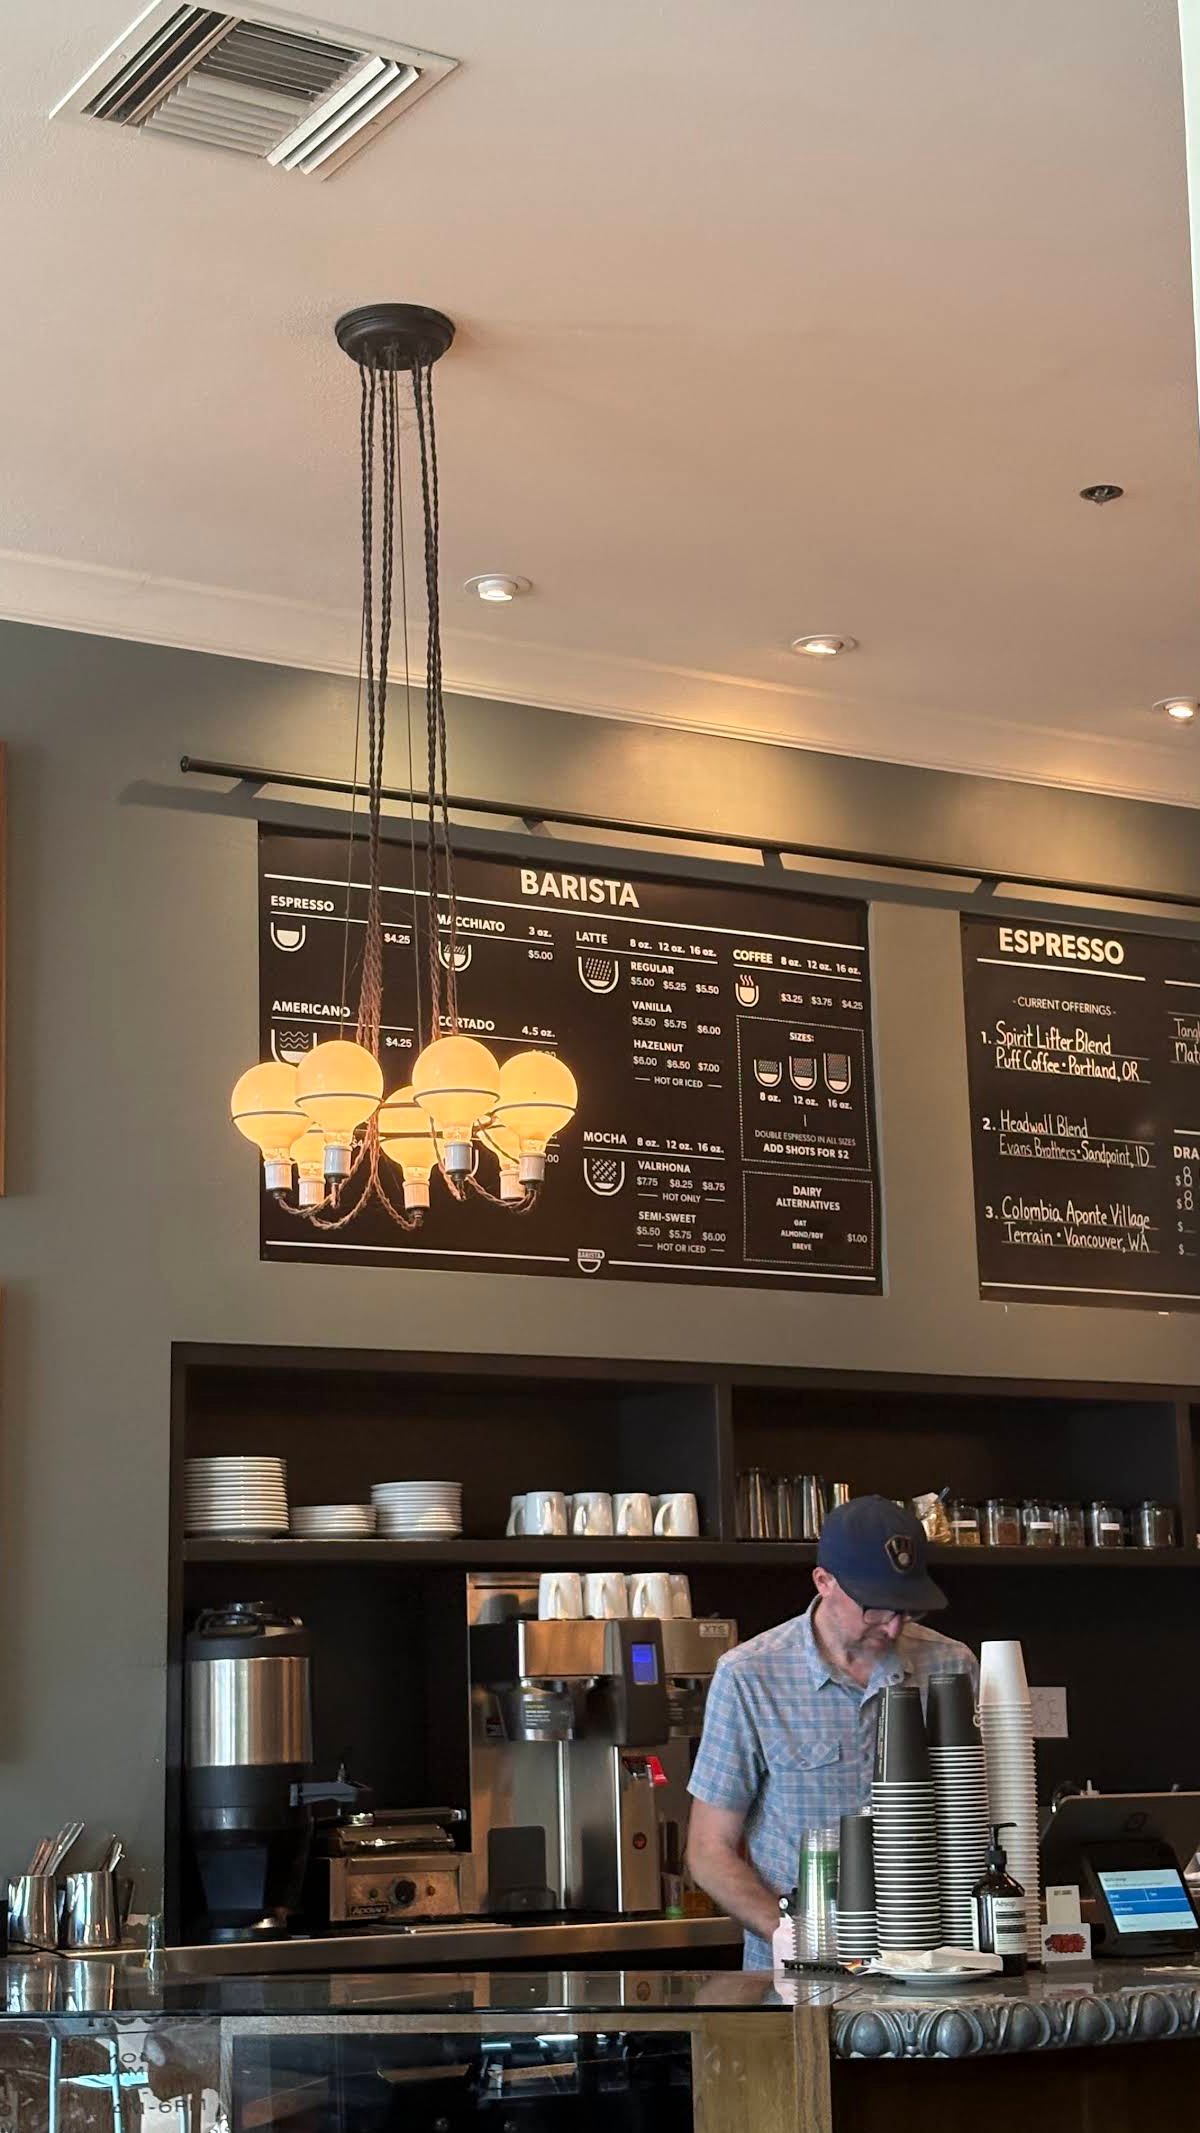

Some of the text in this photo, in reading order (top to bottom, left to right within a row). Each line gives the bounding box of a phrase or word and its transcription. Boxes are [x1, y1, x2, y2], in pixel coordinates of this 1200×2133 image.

[520, 869, 640, 909] BARISTA
[270, 895, 334, 912] ESPRESSO
[384, 932, 410, 944] $4.25
[528, 926, 535, 936] 3
[536, 929, 552, 938] oz.
[576, 930, 717, 957] LATTE 8 oz. 12 oz. 16 oz.
[999, 927, 1124, 965] ESPRESSO
[528, 950, 554, 960] $5.00
[733, 949, 861, 975] COFFEE 8 oz. 12 oz. 16 oz.
[630, 962, 674, 974] REGULAR
[630, 976, 720, 995] $5.00 $5.25 $5.50
[272, 1000, 350, 1018] AMERICANO
[632, 1000, 672, 1014] VANILLA
[781, 993, 863, 1010] $3.25 $3.75 $4.25
[1017, 996, 1112, 1016] CURRENT OFFERINGS
[522, 1026, 539, 1036] 4.5
[540, 1029, 556, 1038] oz.
[632, 1016, 721, 1036] $5.50 $5.75 $6.00
[386, 1036, 412, 1048] $4.25
[790, 1032, 814, 1042] SIZES:
[980, 1031, 992, 1044] 1.
[996, 1020, 1111, 1055] Spirit Lifter Blend
[634, 1039, 684, 1052] HAZELNUT
[1175, 1041, 1200, 1064] Mat
[633, 1056, 658, 1067] $6.00
[698, 1060, 720, 1072] $7.00
[996, 1047, 1140, 1082] Puff Coffee Portland, OR
[654, 1076, 703, 1088] HOT OR ICED
[760, 1092, 852, 1110] 8 oz. 12 oz. 16 oz.
[982, 1118, 996, 1131] 2.
[1000, 1109, 1088, 1138] Headwall Blend
[584, 1131, 724, 1154] MOCHA 8 oz. 12 oz. 16 oz.
[755, 1130, 856, 1146] DOUBLE ESPRESSO IN ALL SIZES
[764, 1143, 849, 1160] ADD SHOTS FOR $2
[1000, 1134, 1032, 1156] Evans
[1081, 1140, 1134, 1168] Sandpoint,
[1136, 1146, 1150, 1166] ID
[638, 1160, 691, 1174] VALRHONA
[662, 1192, 701, 1204] HOT ONLY
[792, 1186, 822, 1198] DAIRY
[776, 1198, 840, 1211] ALTERNATIVES
[638, 1211, 696, 1224] SEMI-SWEET
[985, 1206, 999, 1220] 3.
[1002, 1196, 1150, 1234] Colombia Aponte Village
[636, 1226, 726, 1242] $5.50 $5.75 $6.00
[848, 1234, 868, 1244] $1.00
[1004, 1222, 1150, 1253] Terrain Vancouver, WA
[657, 1242, 706, 1254] HOT OR ICED
